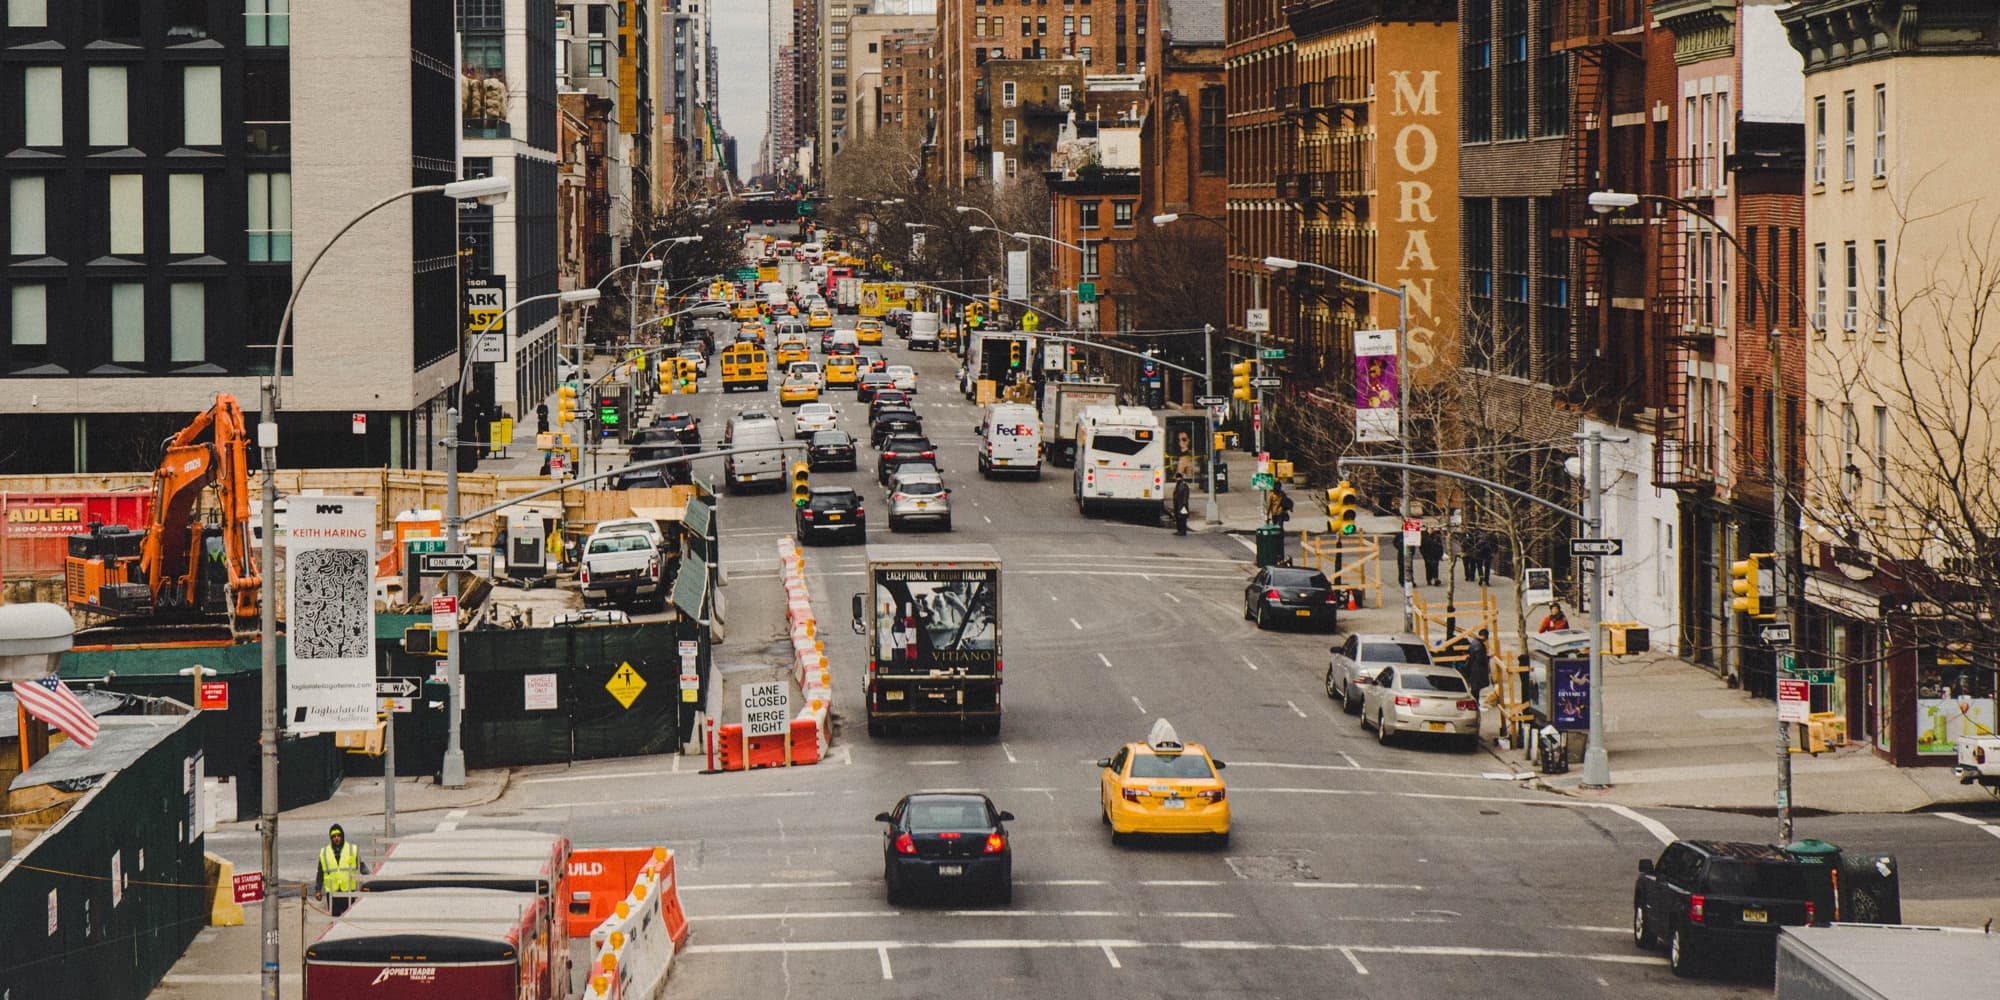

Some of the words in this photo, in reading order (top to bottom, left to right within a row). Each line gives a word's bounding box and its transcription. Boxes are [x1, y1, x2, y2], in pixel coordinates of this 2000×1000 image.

[1389, 70, 1441, 369] MORAN'S
[467, 278, 487, 287] ison
[468, 293, 498, 306] ARK
[469, 312, 498, 326] AST
[996, 424, 1033, 436] FedEx
[316, 504, 344, 514] NYC
[8, 508, 79, 522] ADLER
[293, 528, 320, 538] KEITH
[324, 528, 367, 538] HARING
[413, 542, 421, 552] W
[425, 542, 435, 552] 18
[886, 571, 928, 580] EXCEPTIONAL
[962, 571, 987, 581] ITALIAN
[932, 651, 991, 661] VITIANO
[393, 684, 411, 692] WAY
[752, 685, 779, 696] LANE
[745, 696, 787, 708] CLOSED
[748, 710, 784, 722] MERGE
[751, 721, 782, 733] RIGHT
[568, 862, 603, 876] UILD
[241, 874, 262, 883] STANDING
